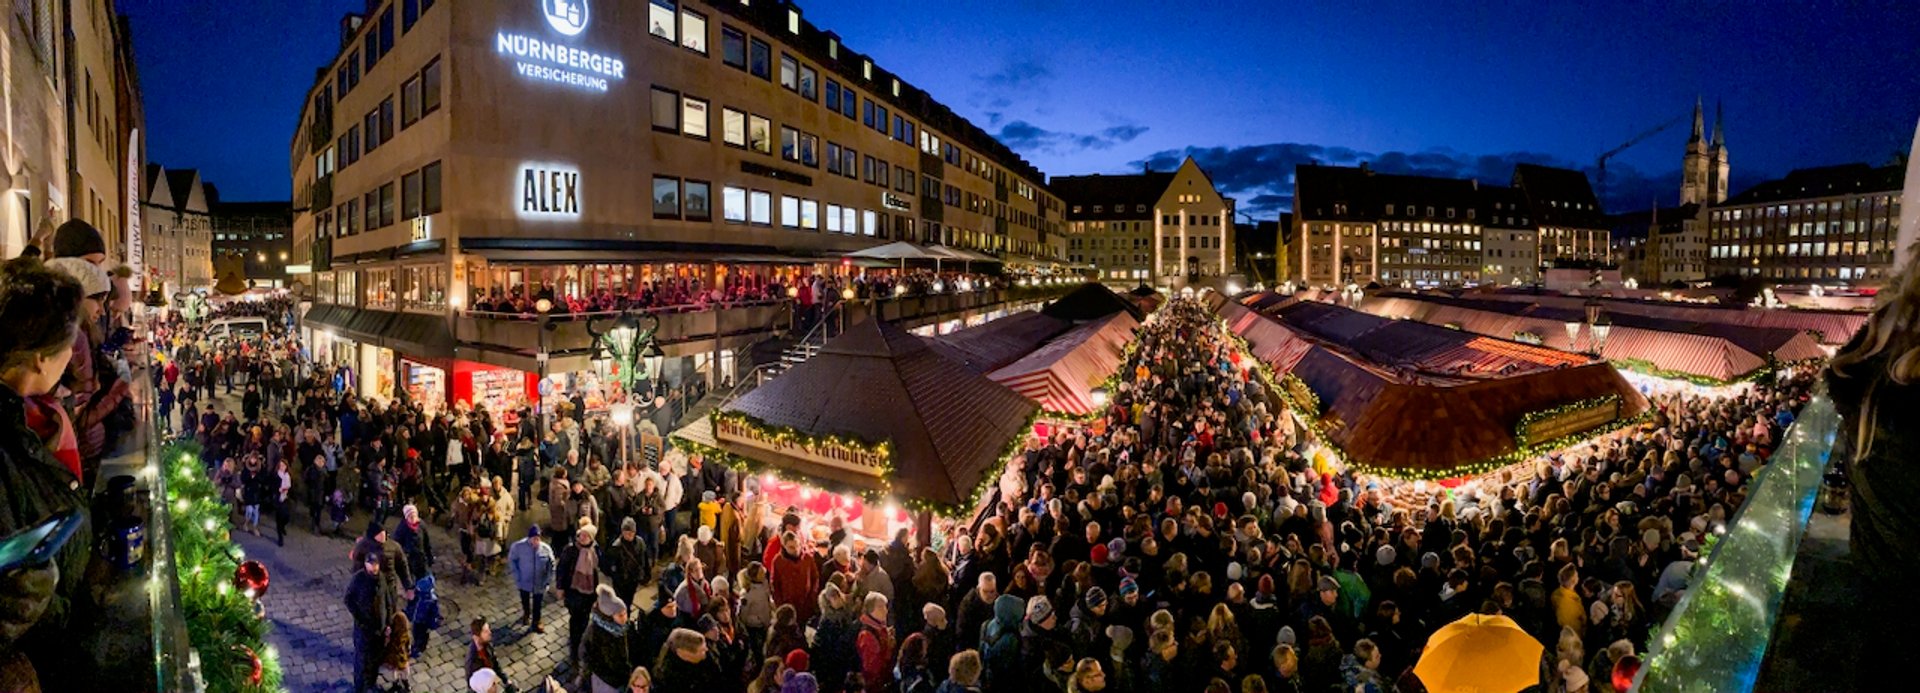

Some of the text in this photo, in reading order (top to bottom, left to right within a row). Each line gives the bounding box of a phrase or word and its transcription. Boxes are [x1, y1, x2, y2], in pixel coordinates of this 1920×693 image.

[498, 33, 624, 78] NÜRNBERGER
[517, 62, 608, 91] VERSICHERUNG
[523, 169, 578, 213] ALEX
[801, 441, 884, 467] ratwurst
